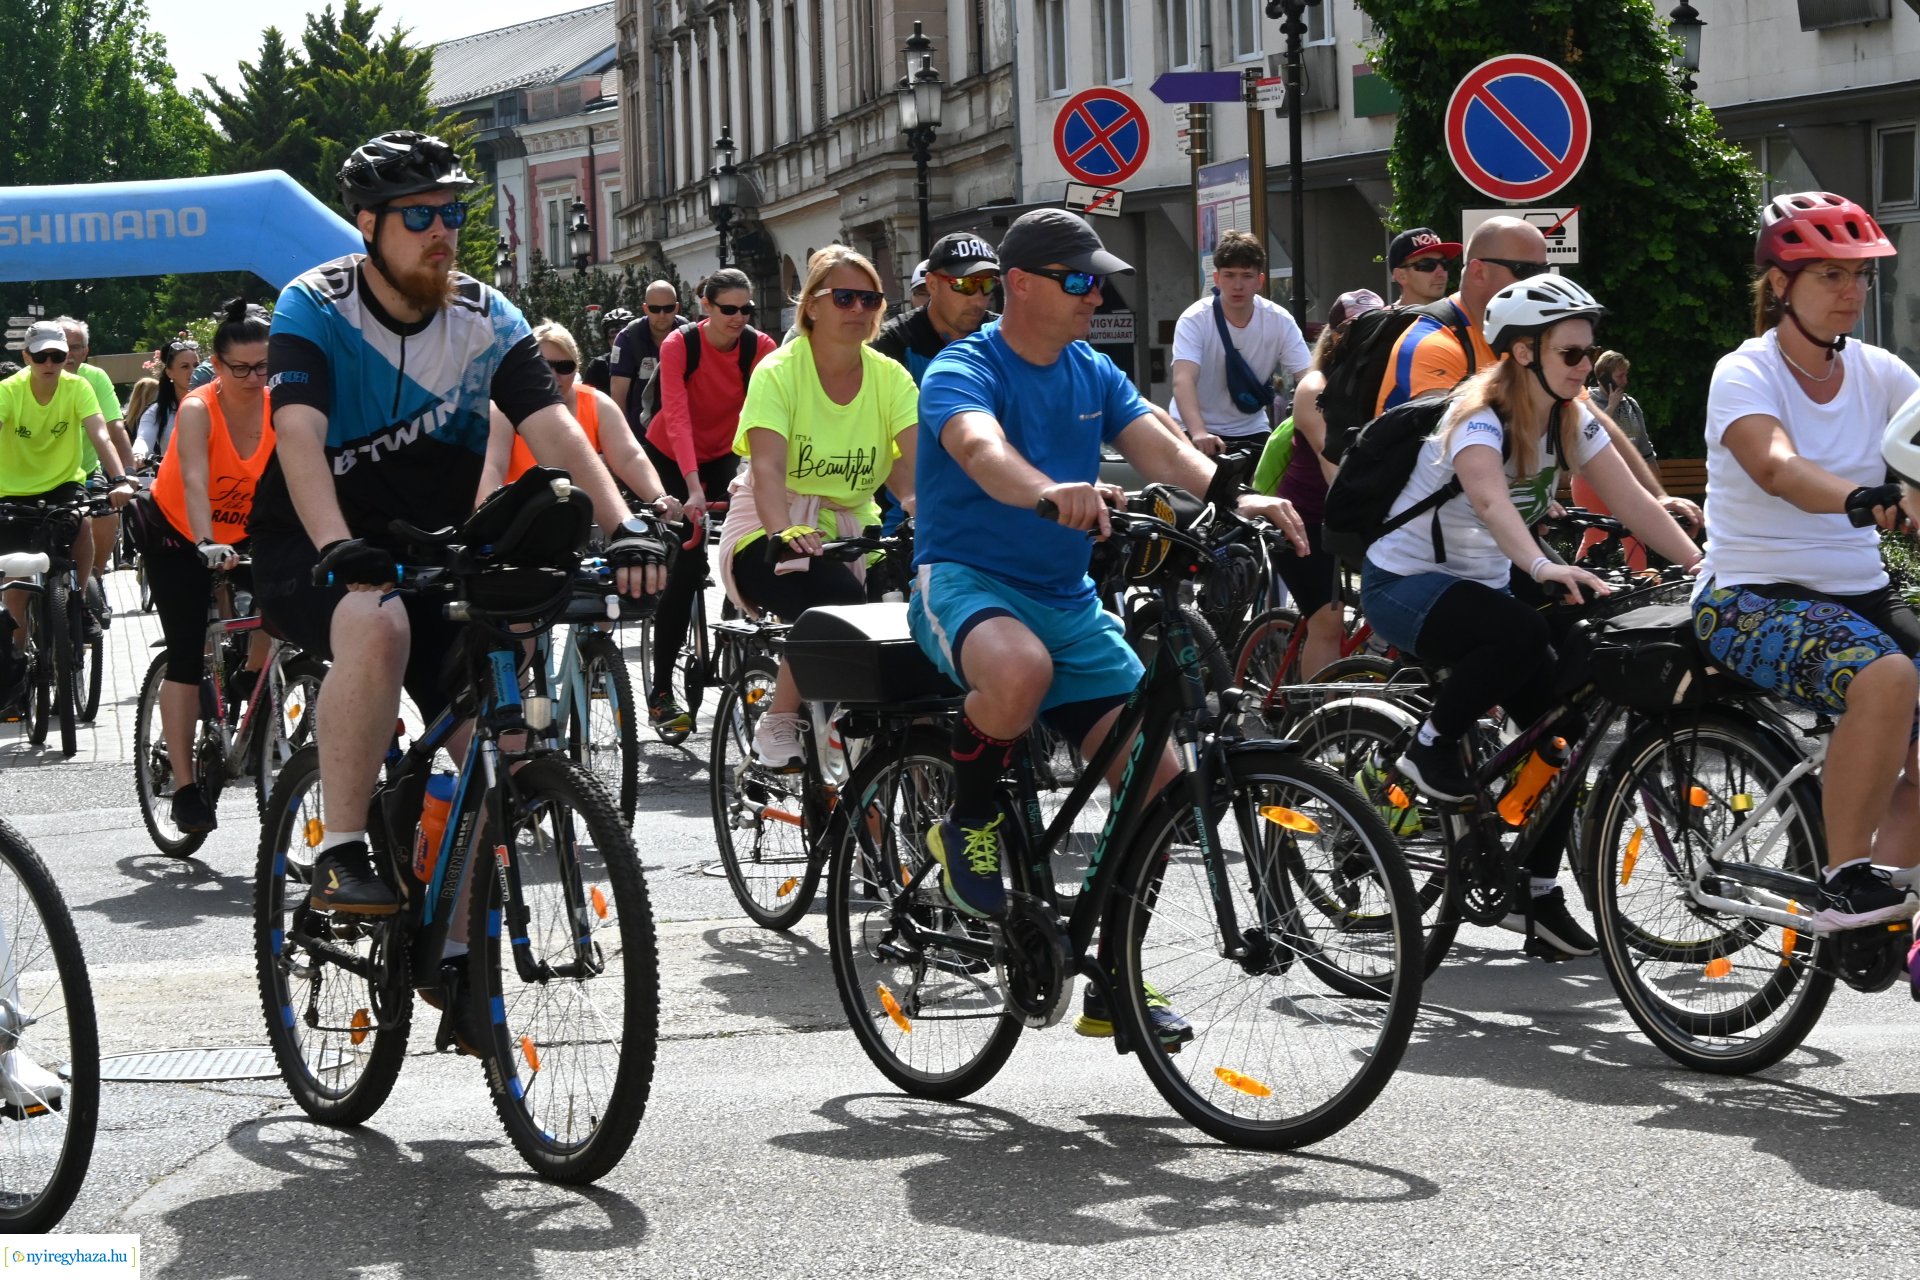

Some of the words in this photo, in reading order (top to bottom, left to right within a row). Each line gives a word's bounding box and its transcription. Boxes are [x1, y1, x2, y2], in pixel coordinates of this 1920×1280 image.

[0, 207, 207, 246] SHIMANO
[1090, 316, 1132, 328] VIGYÁZZ
[789, 442, 876, 491] Beautiful
